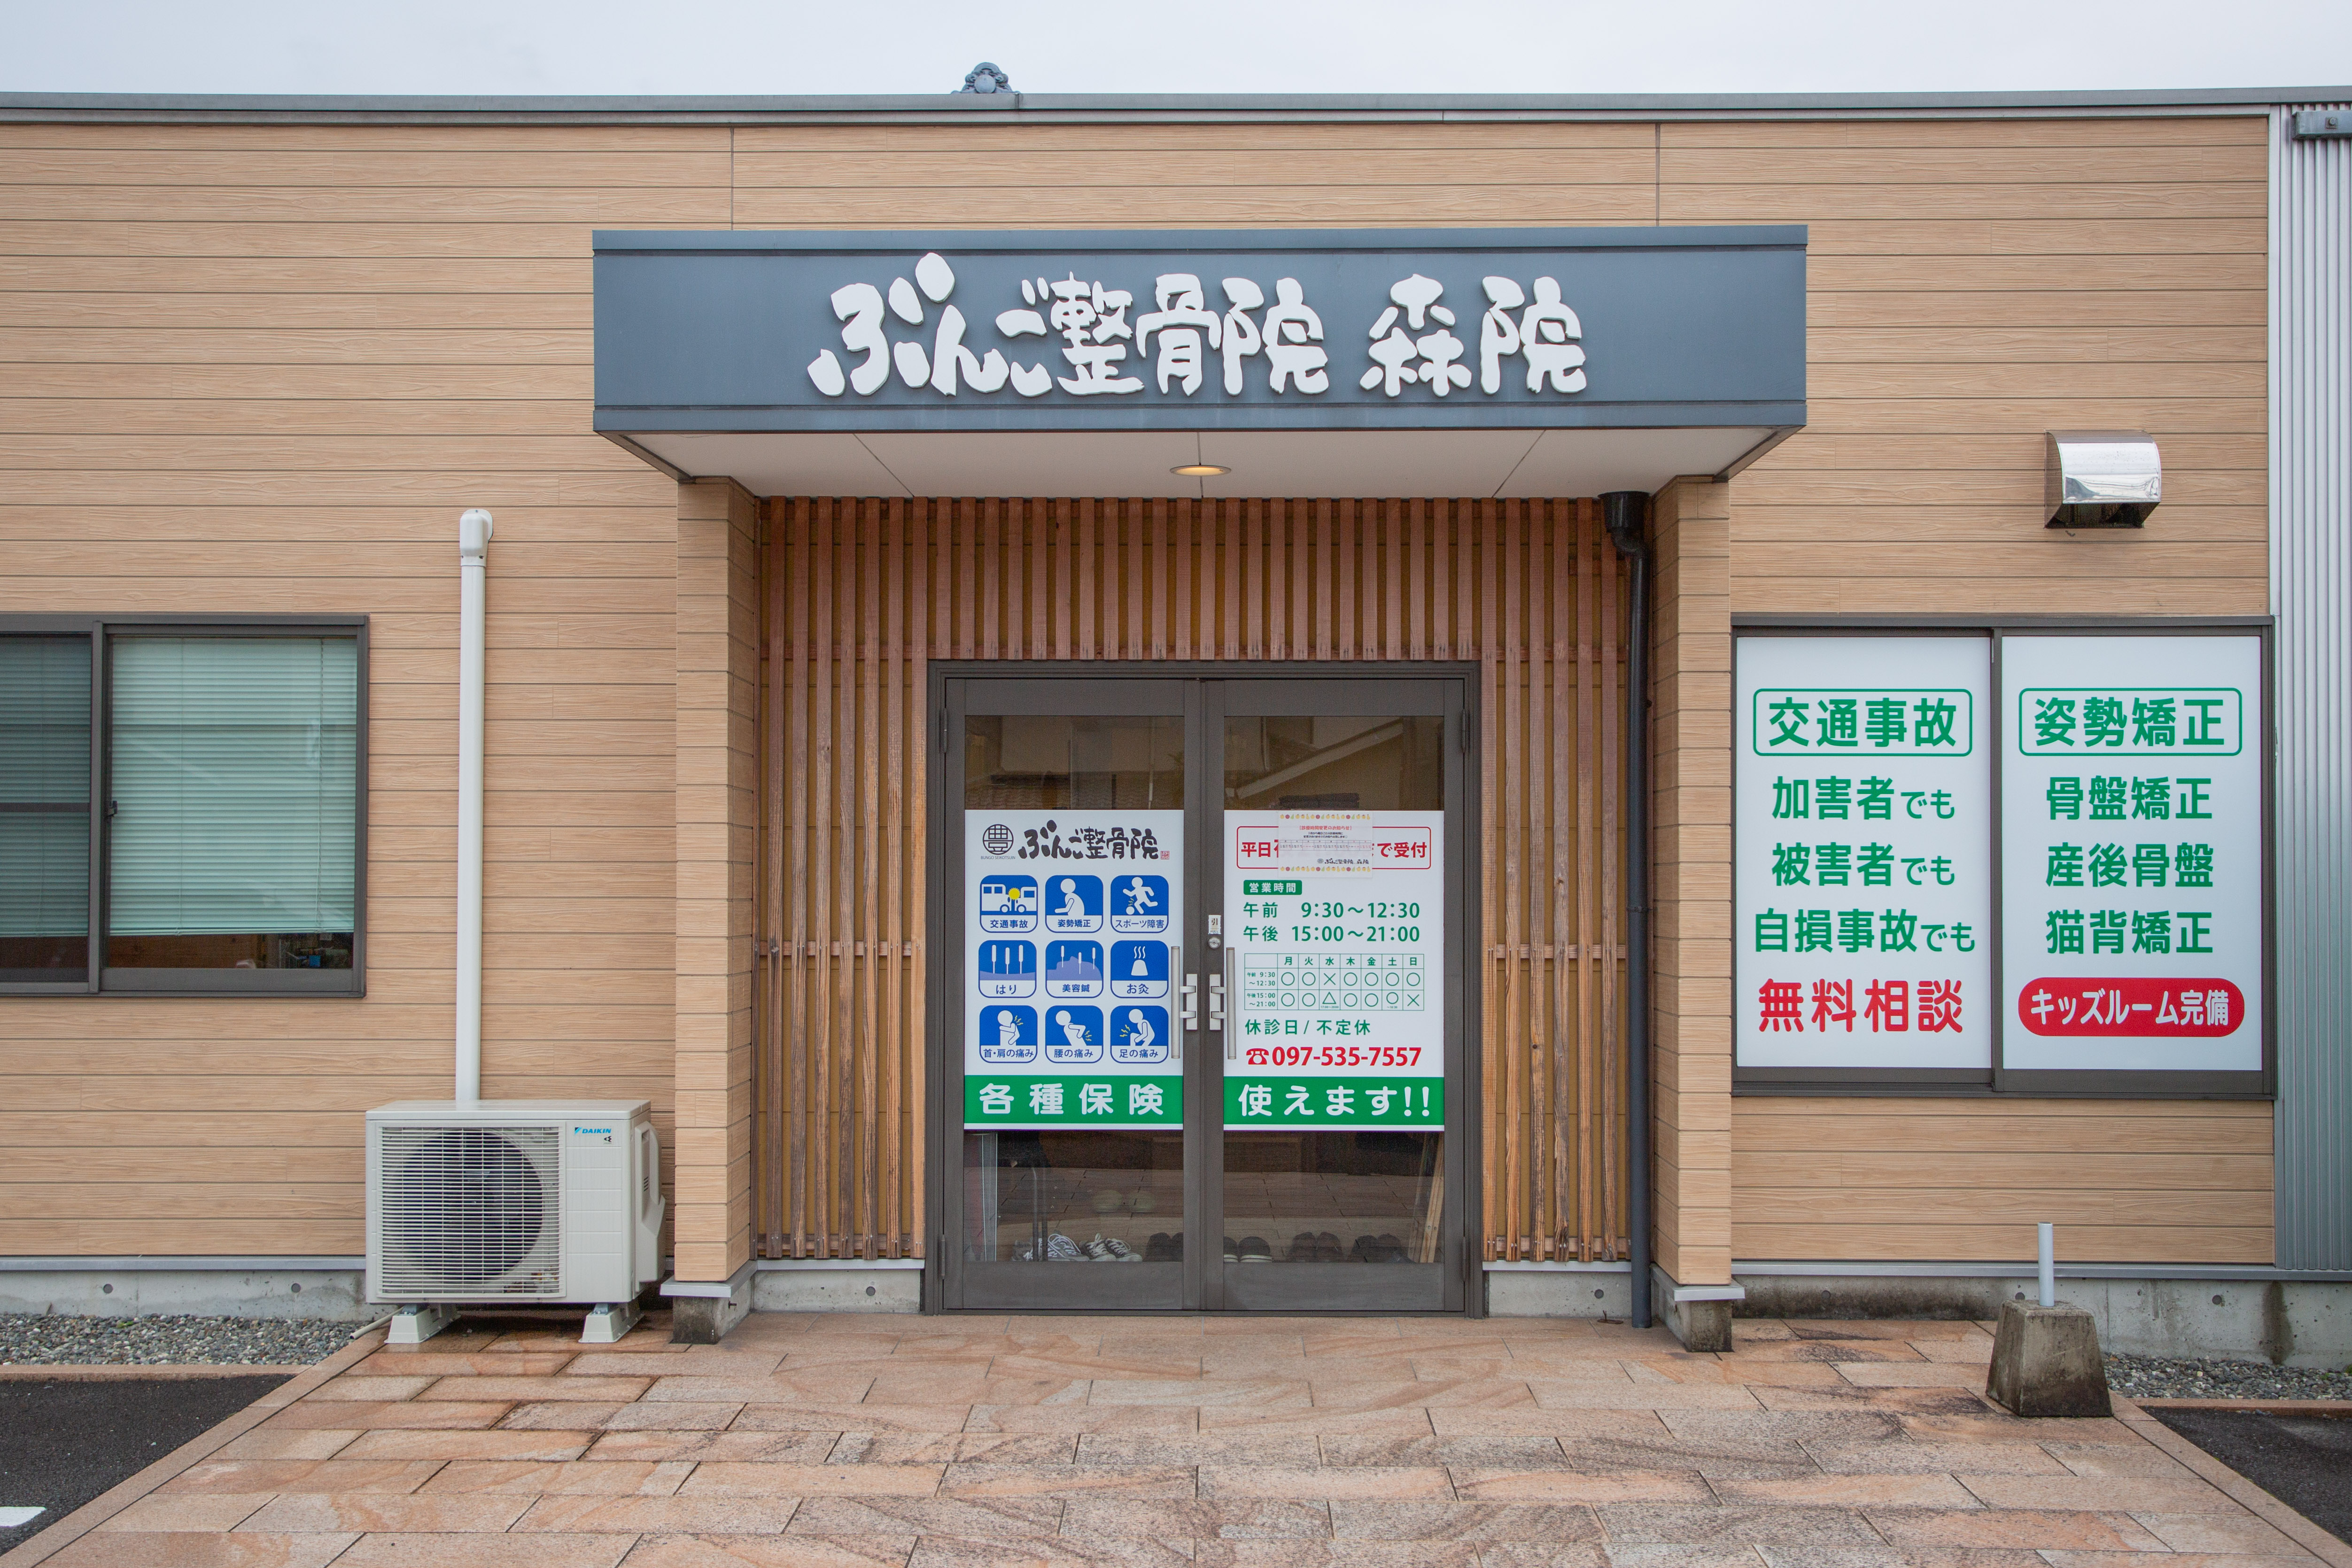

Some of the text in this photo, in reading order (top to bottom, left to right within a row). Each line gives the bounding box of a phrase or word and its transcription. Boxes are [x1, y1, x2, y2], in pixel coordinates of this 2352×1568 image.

[807, 253, 1586, 396] ぶんご整骨院 森院
[1769, 697, 1957, 747] 交通事故
[2035, 697, 2225, 747] 姿勢矯正
[1772, 776, 1955, 820] 加害者でも
[2047, 775, 2212, 820] 骨盤矯正
[1018, 820, 1158, 859] ぶんご整骨院
[1372, 842, 1427, 857] で受付
[1772, 842, 1955, 886] 被害者でも
[2046, 842, 2214, 887] 産後骨盤
[1250, 883, 1295, 892] 営業時間
[1244, 902, 1278, 917] 午前
[1115, 919, 1164, 928] スポーツ障害
[1755, 908, 1975, 953] 自損事故でも
[1244, 926, 1278, 941] 午後
[2046, 909, 2213, 955] 猫背矯正
[1284, 956, 1293, 965] 月
[1305, 957, 1313, 966] 火
[1325, 956, 1334, 966] 水
[1346, 956, 1355, 966] 木
[1367, 956, 1376, 966] 金
[1387, 957, 1398, 966] 土
[1409, 956, 1418, 966] 日
[996, 985, 1016, 994] はり
[1127, 984, 1148, 994] お灸
[1759, 978, 1962, 1032] 無料相談
[2031, 988, 2228, 1026] キッズルーム完備
[984, 1049, 1033, 1057] 首・肩の痛み
[1054, 1049, 1092, 1057] 腰の痛み
[1120, 1049, 1157, 1057] 足の痛み
[1273, 1047, 1421, 1066] 097-535-7557
[980, 1084, 1163, 1114] 各種保険
[1239, 1085, 1429, 1116] 使えます!!
